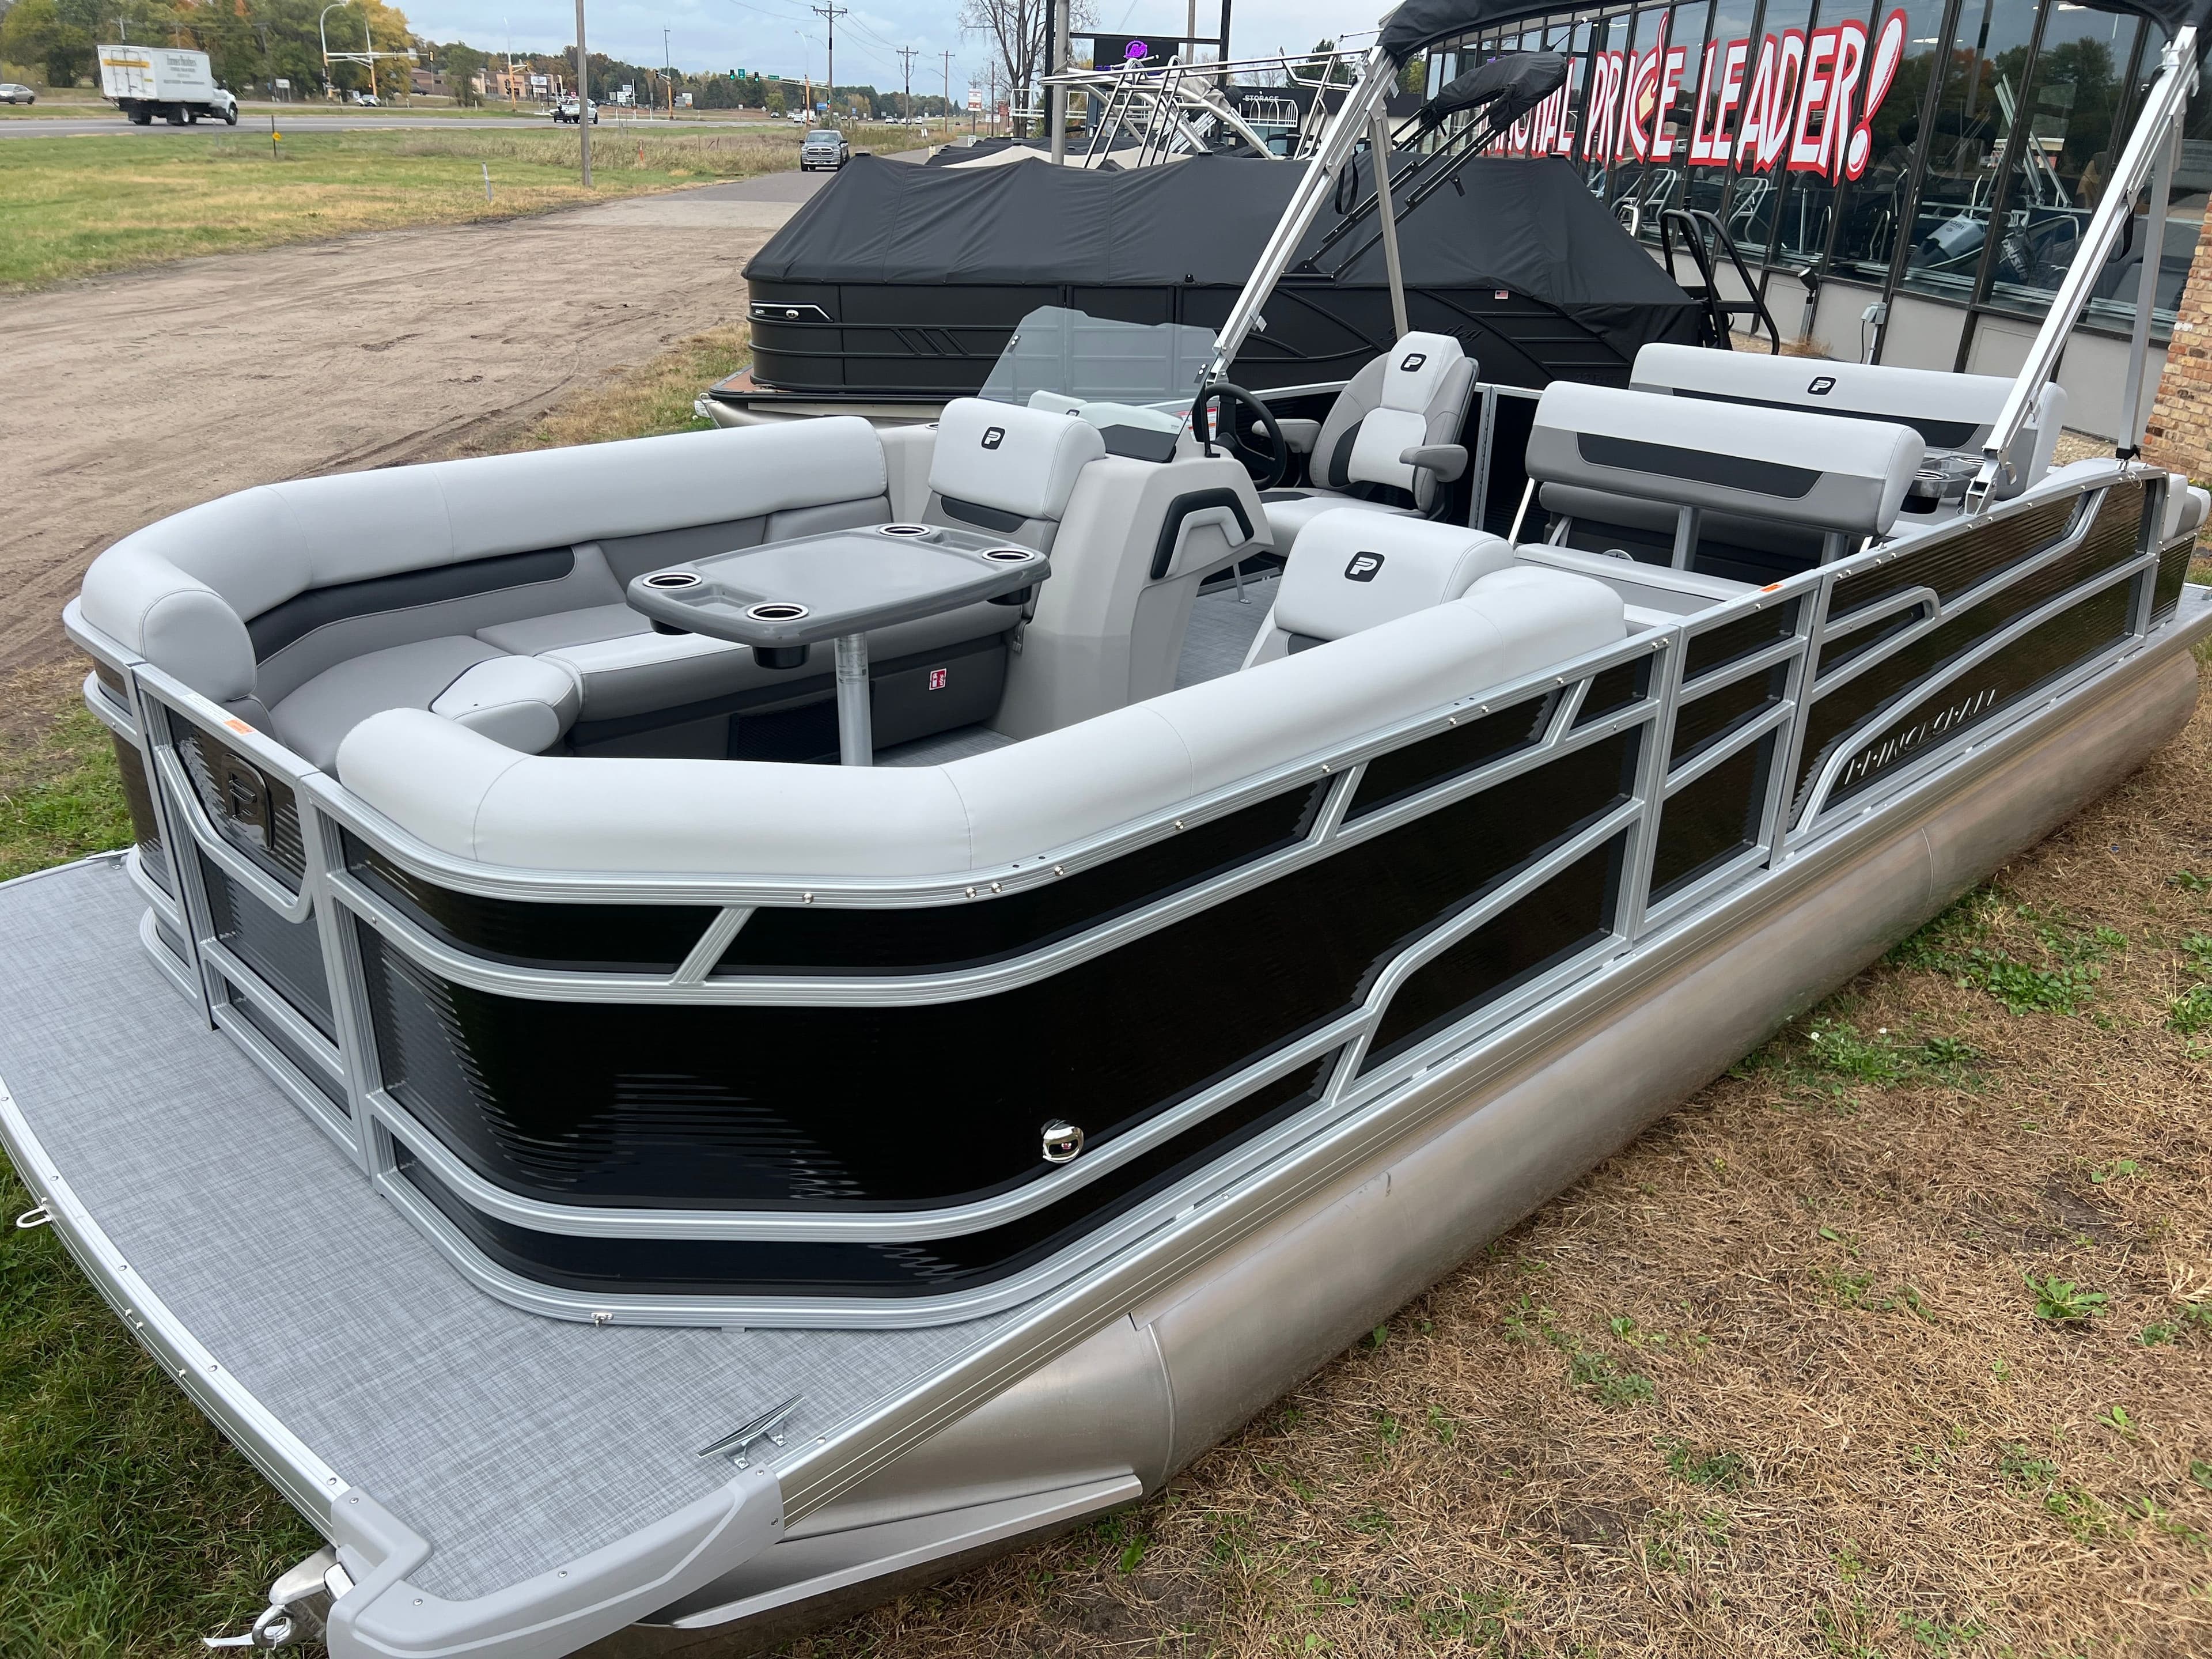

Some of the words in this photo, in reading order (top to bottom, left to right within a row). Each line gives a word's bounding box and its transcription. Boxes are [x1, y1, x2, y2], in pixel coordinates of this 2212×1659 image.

[1244, 94, 1280, 103] STORAGE
[1582, 46, 1687, 171] PRICE
[1688, 7, 1908, 185] LEADER!
